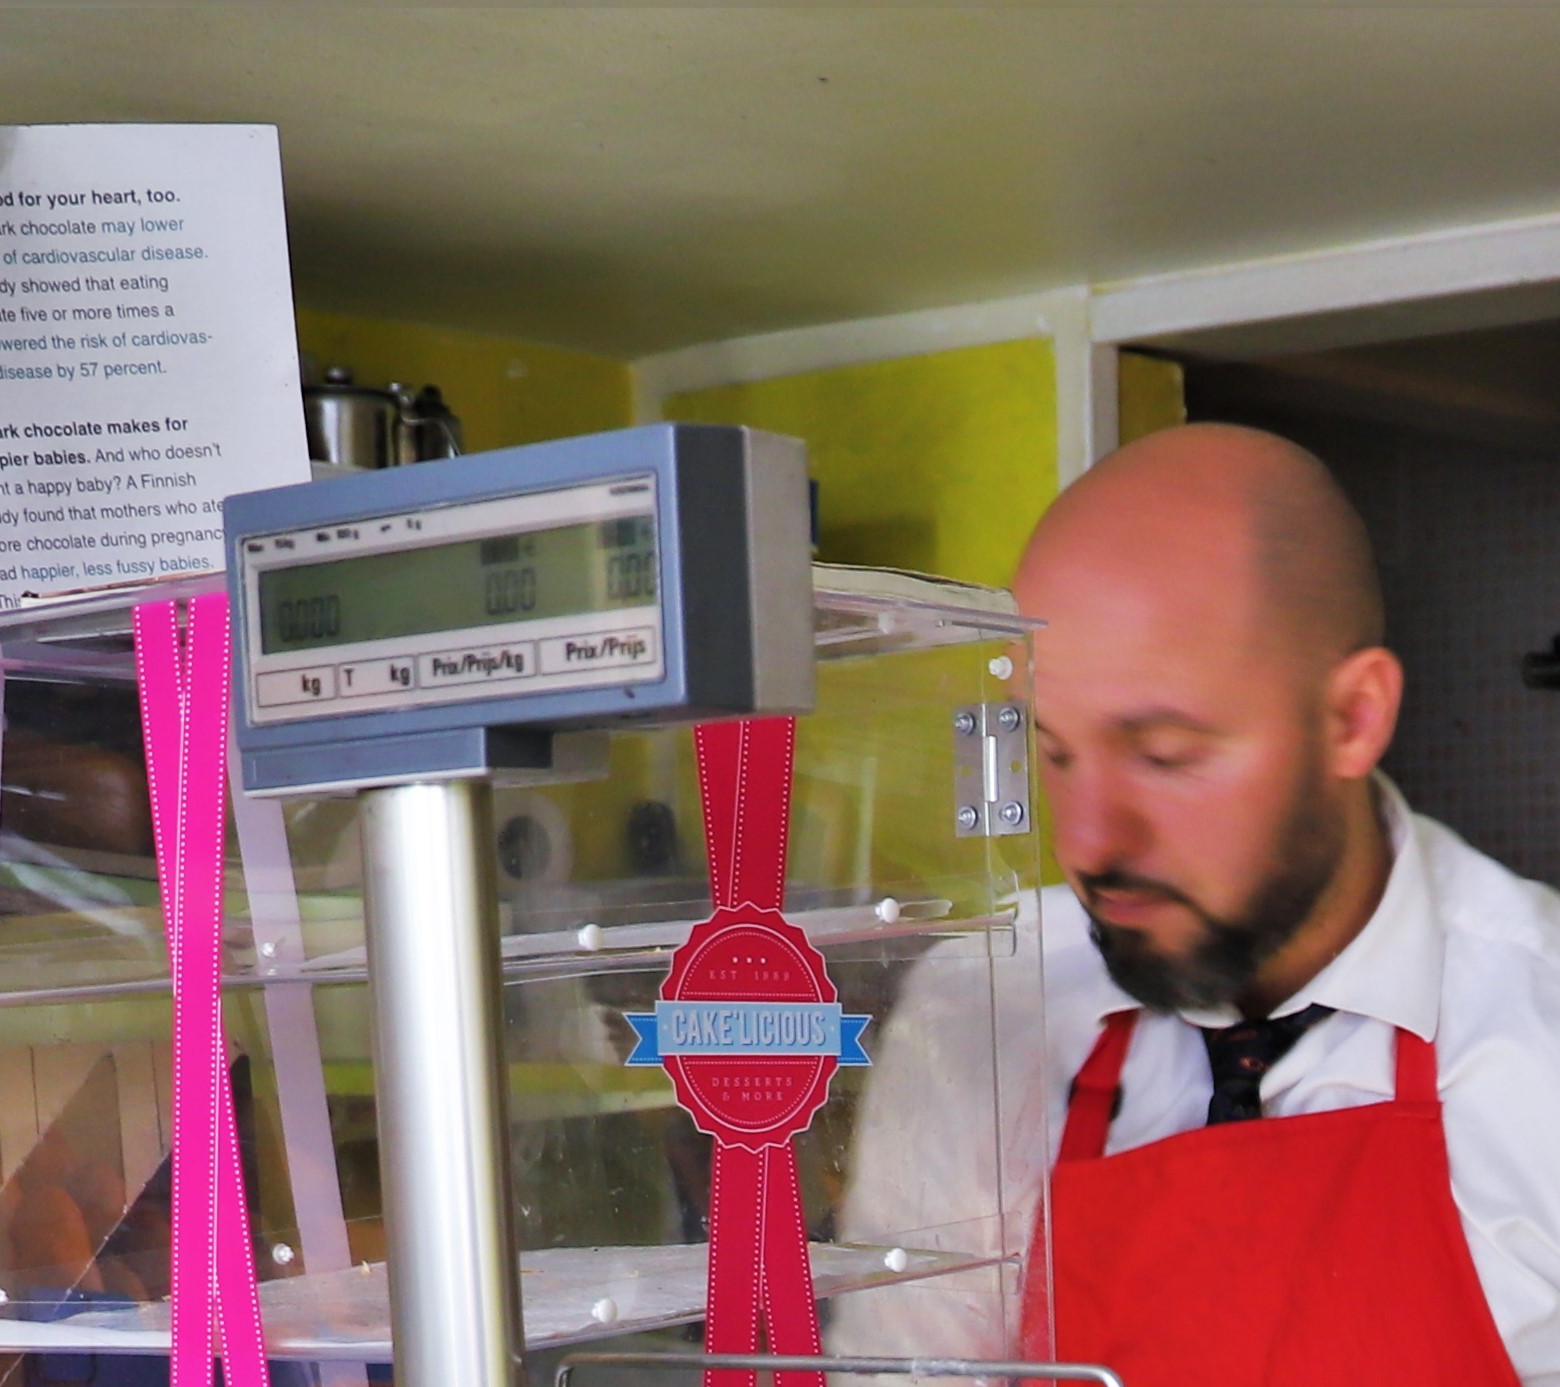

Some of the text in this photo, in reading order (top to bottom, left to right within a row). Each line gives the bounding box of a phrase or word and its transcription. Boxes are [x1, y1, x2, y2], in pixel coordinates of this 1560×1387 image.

[17, 188, 42, 207] for
[46, 191, 87, 210] your
[91, 187, 142, 210] heart,
[146, 186, 180, 205] too.
[19, 216, 96, 236] chocolate
[101, 220, 136, 239] may
[140, 215, 184, 234] lower
[23, 417, 103, 438] chocolate
[106, 415, 161, 435] makes
[164, 414, 188, 433] for
[33, 445, 91, 466] babies.
[95, 444, 125, 464] And
[128, 442, 164, 462] who
[163, 440, 222, 461] doesn't
[301, 673, 321, 696] kg
[390, 663, 410, 686] kg
[566, 634, 646, 662] Prix/Prijs
[671, 1009, 826, 1047] CAKE'LICIOUS
[712, 1077, 793, 1088] DESSERTS
[742, 1091, 784, 1101] MORE
